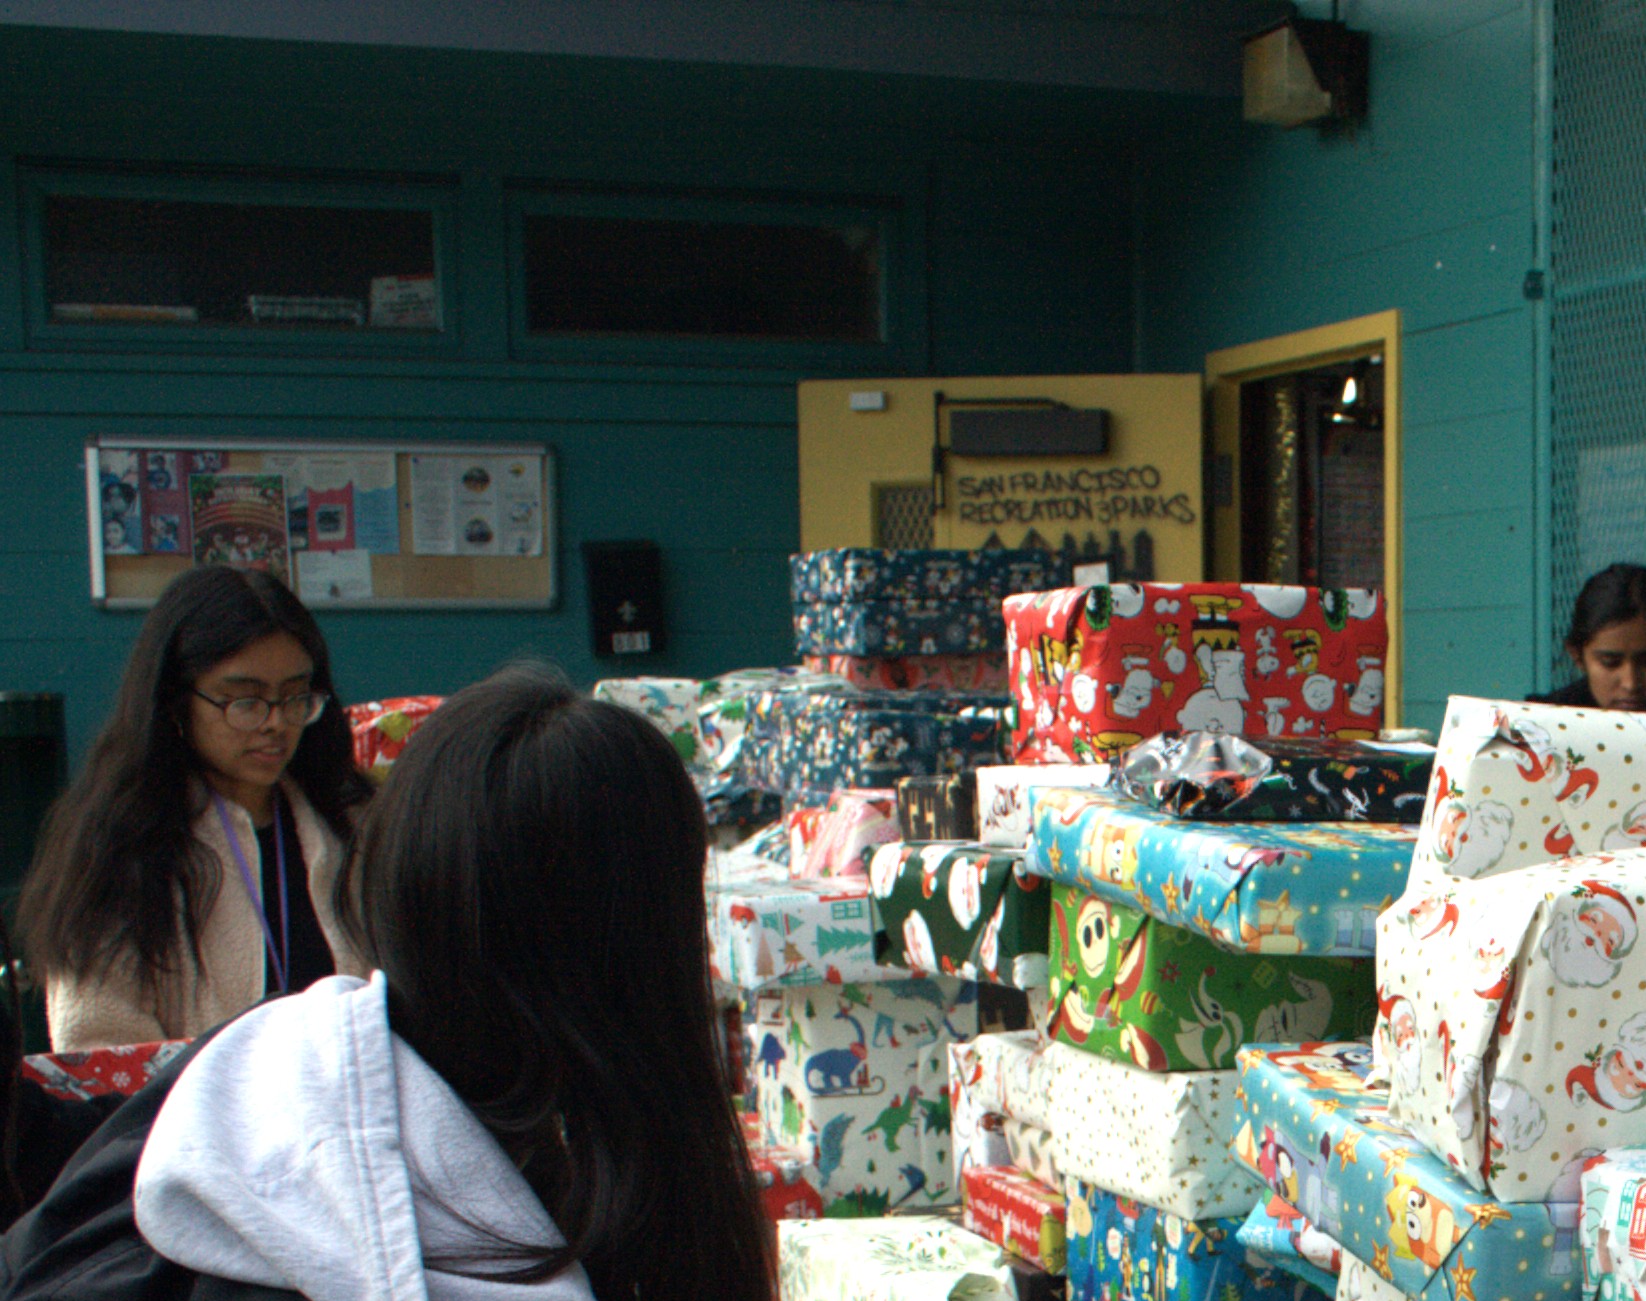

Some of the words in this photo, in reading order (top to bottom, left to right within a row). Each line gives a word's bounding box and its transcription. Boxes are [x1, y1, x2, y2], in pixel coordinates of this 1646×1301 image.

[957, 475, 1005, 500] SAN
[1009, 464, 1161, 494] FRANCISCO
[959, 497, 1094, 524] RECREATION
[1112, 493, 1196, 524] PARKS
